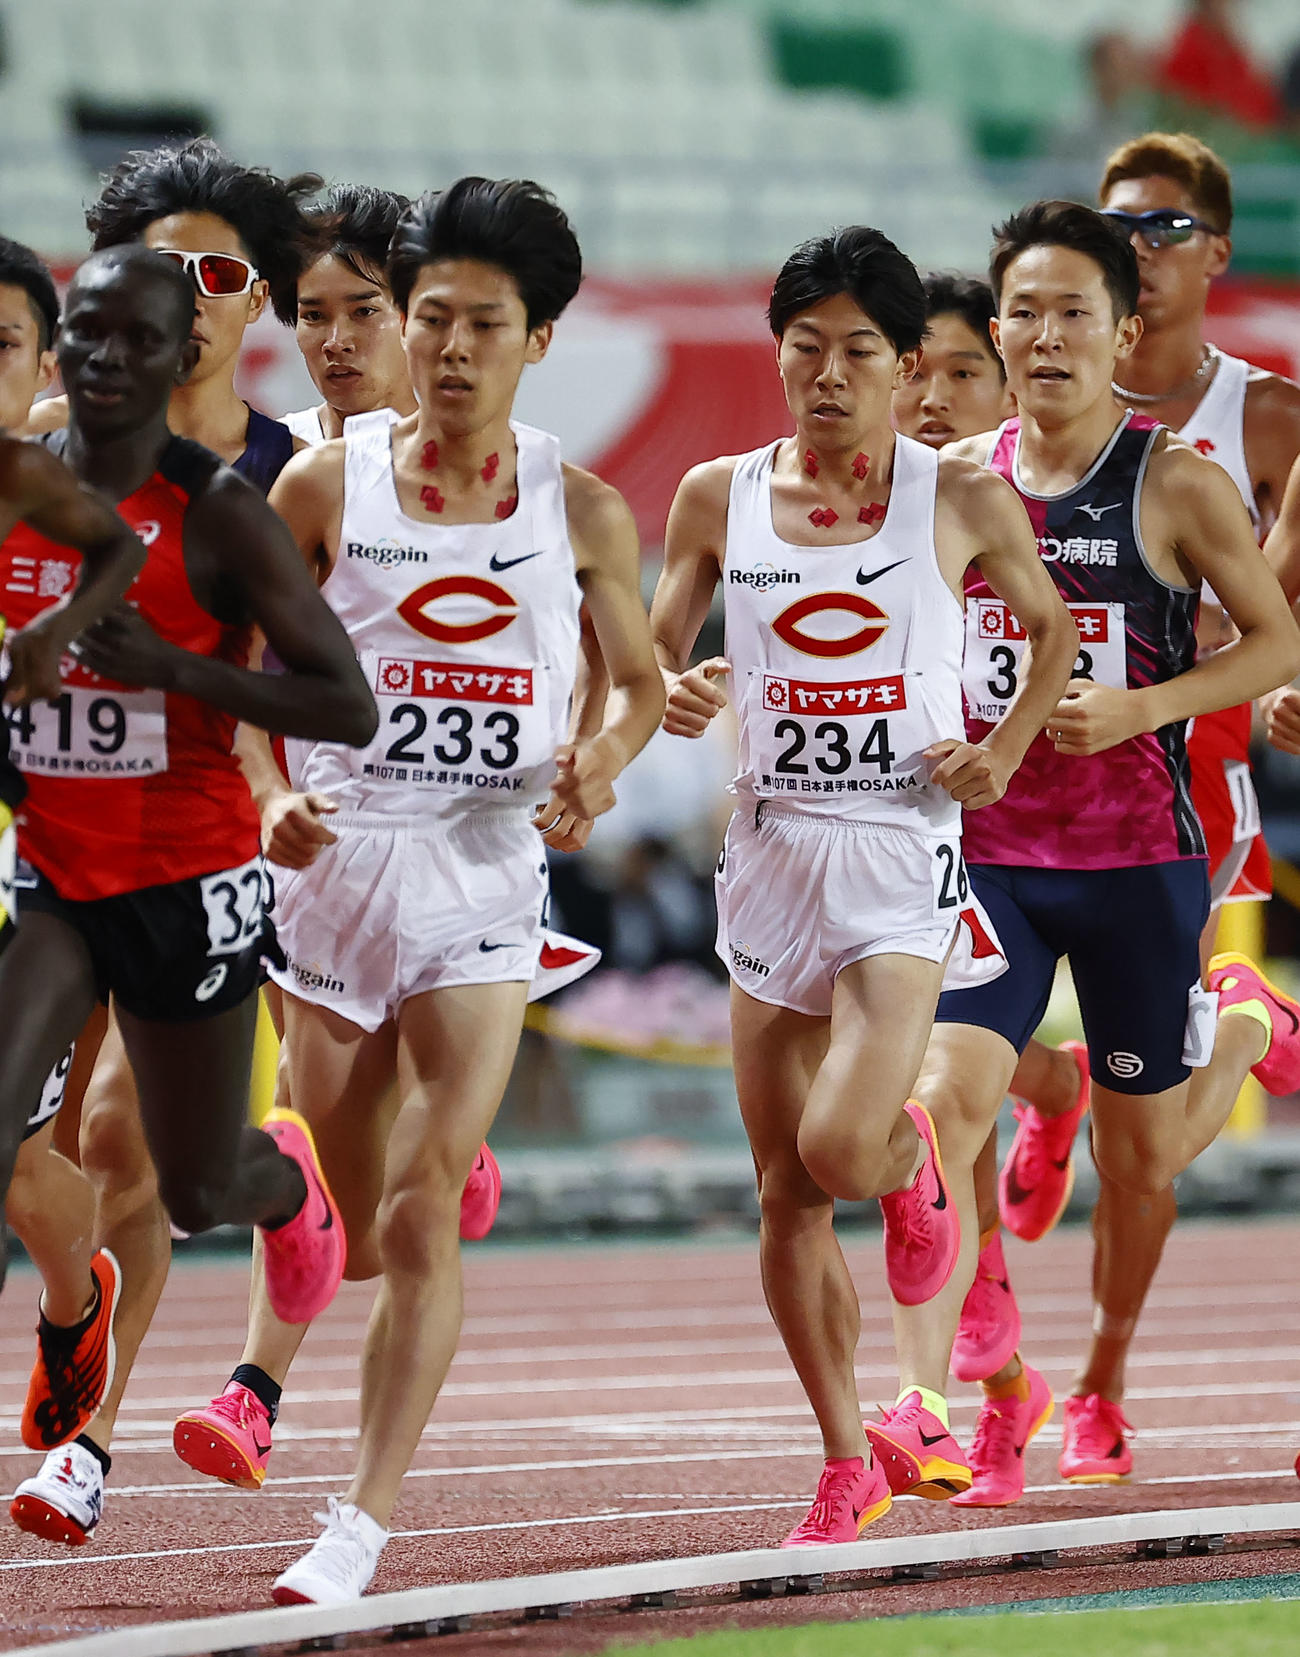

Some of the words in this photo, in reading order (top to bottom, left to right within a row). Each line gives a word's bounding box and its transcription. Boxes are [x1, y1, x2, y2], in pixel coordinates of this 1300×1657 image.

[347, 543, 428, 564] Regain
[1036, 537, 1118, 566] つ病院
[6, 556, 80, 597] 三菱
[730, 569, 800, 586] Regain
[420, 668, 530, 699] ヤマザキ
[795, 685, 898, 710] ヤマザキ
[386, 704, 519, 769] 233
[774, 719, 895, 775] 234
[412, 768, 524, 791] 日本選手権OSAK
[936, 844, 967, 909] 26
